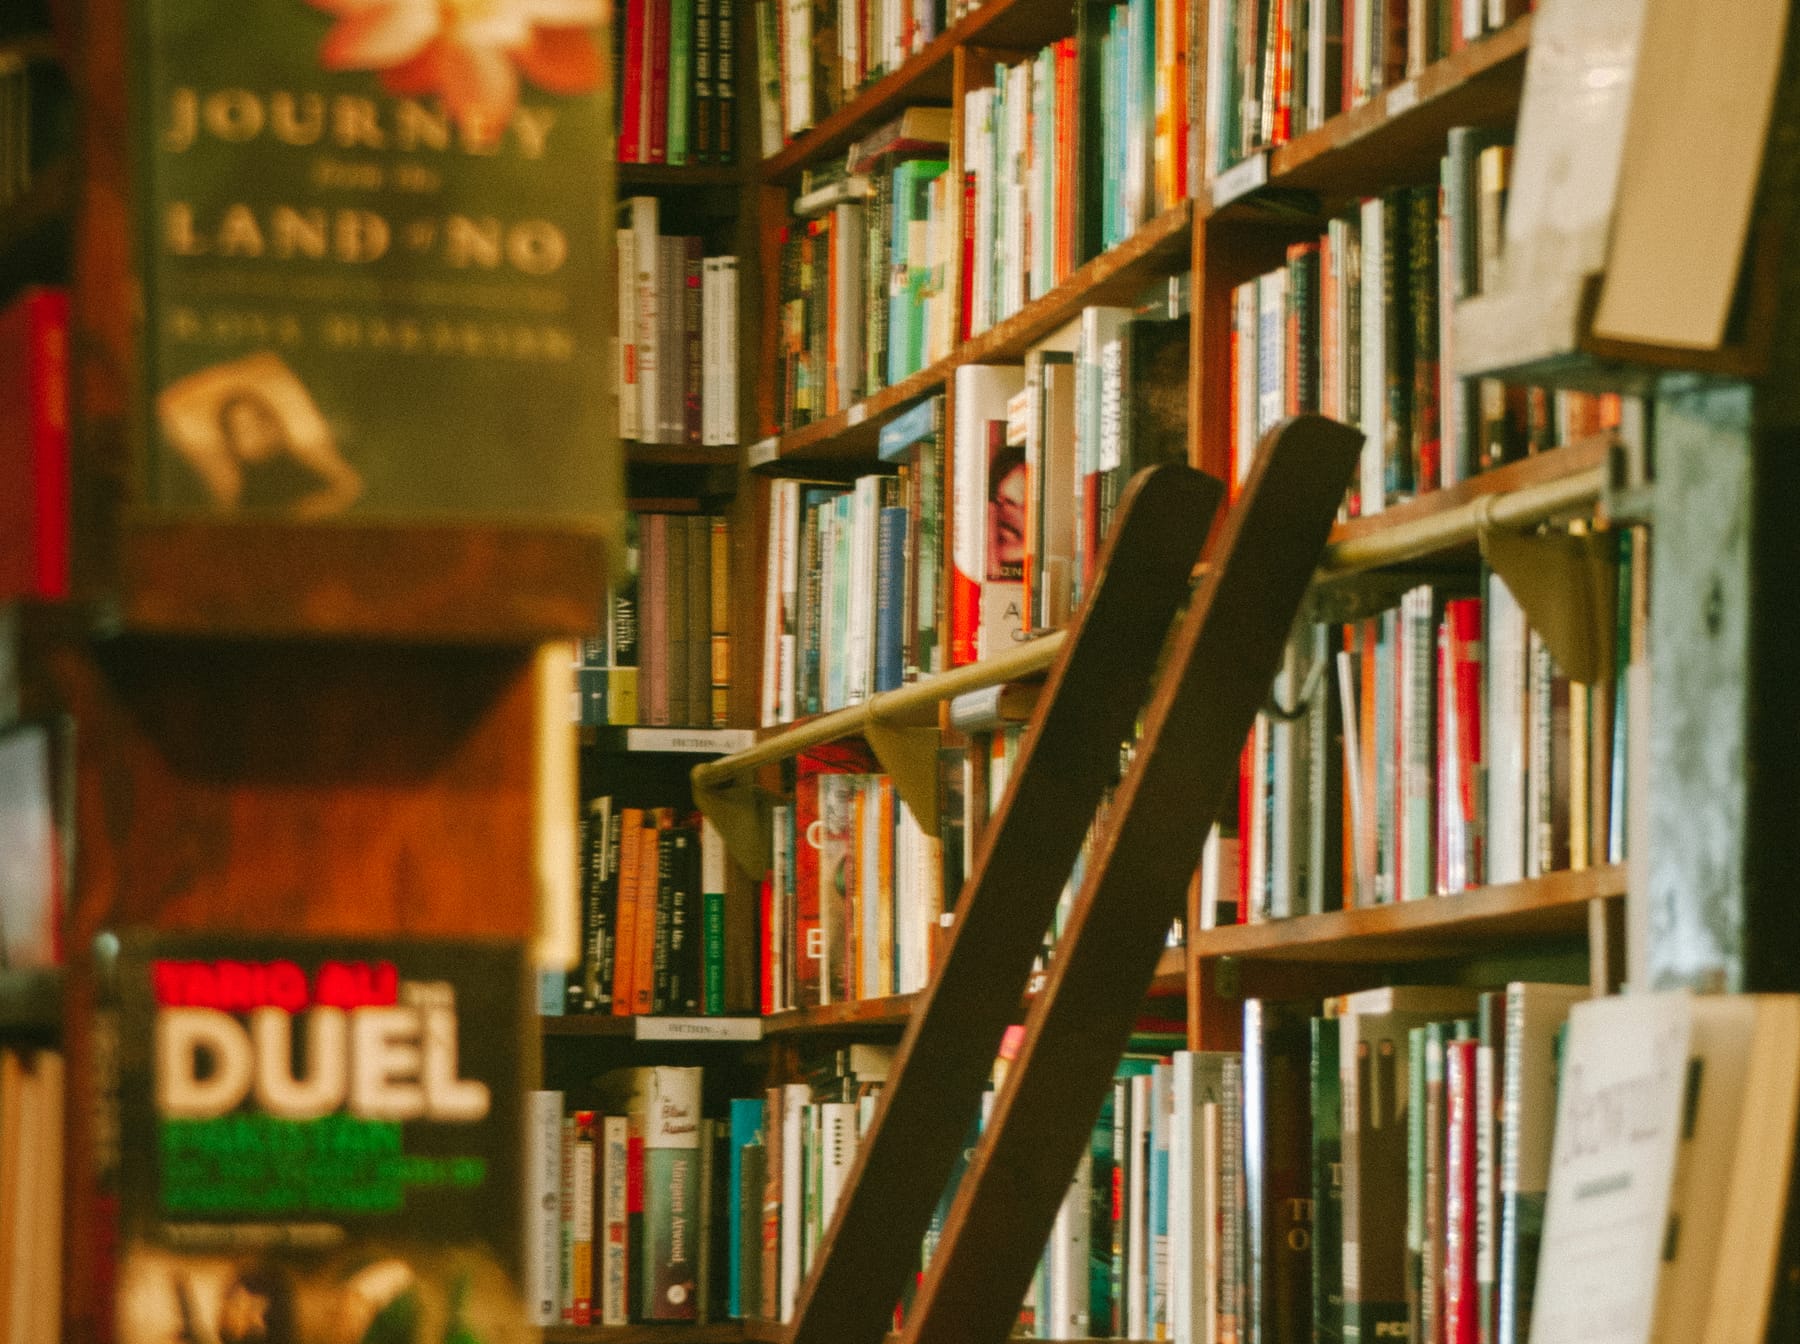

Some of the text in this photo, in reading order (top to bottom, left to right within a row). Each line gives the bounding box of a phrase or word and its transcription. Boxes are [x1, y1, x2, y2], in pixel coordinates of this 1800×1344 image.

[163, 202, 391, 263] LAND
[443, 214, 569, 276] NO
[616, 597, 634, 653] Allende
[156, 1005, 491, 1122] DUEL
[671, 1159, 688, 1262] Margaret Atwood
